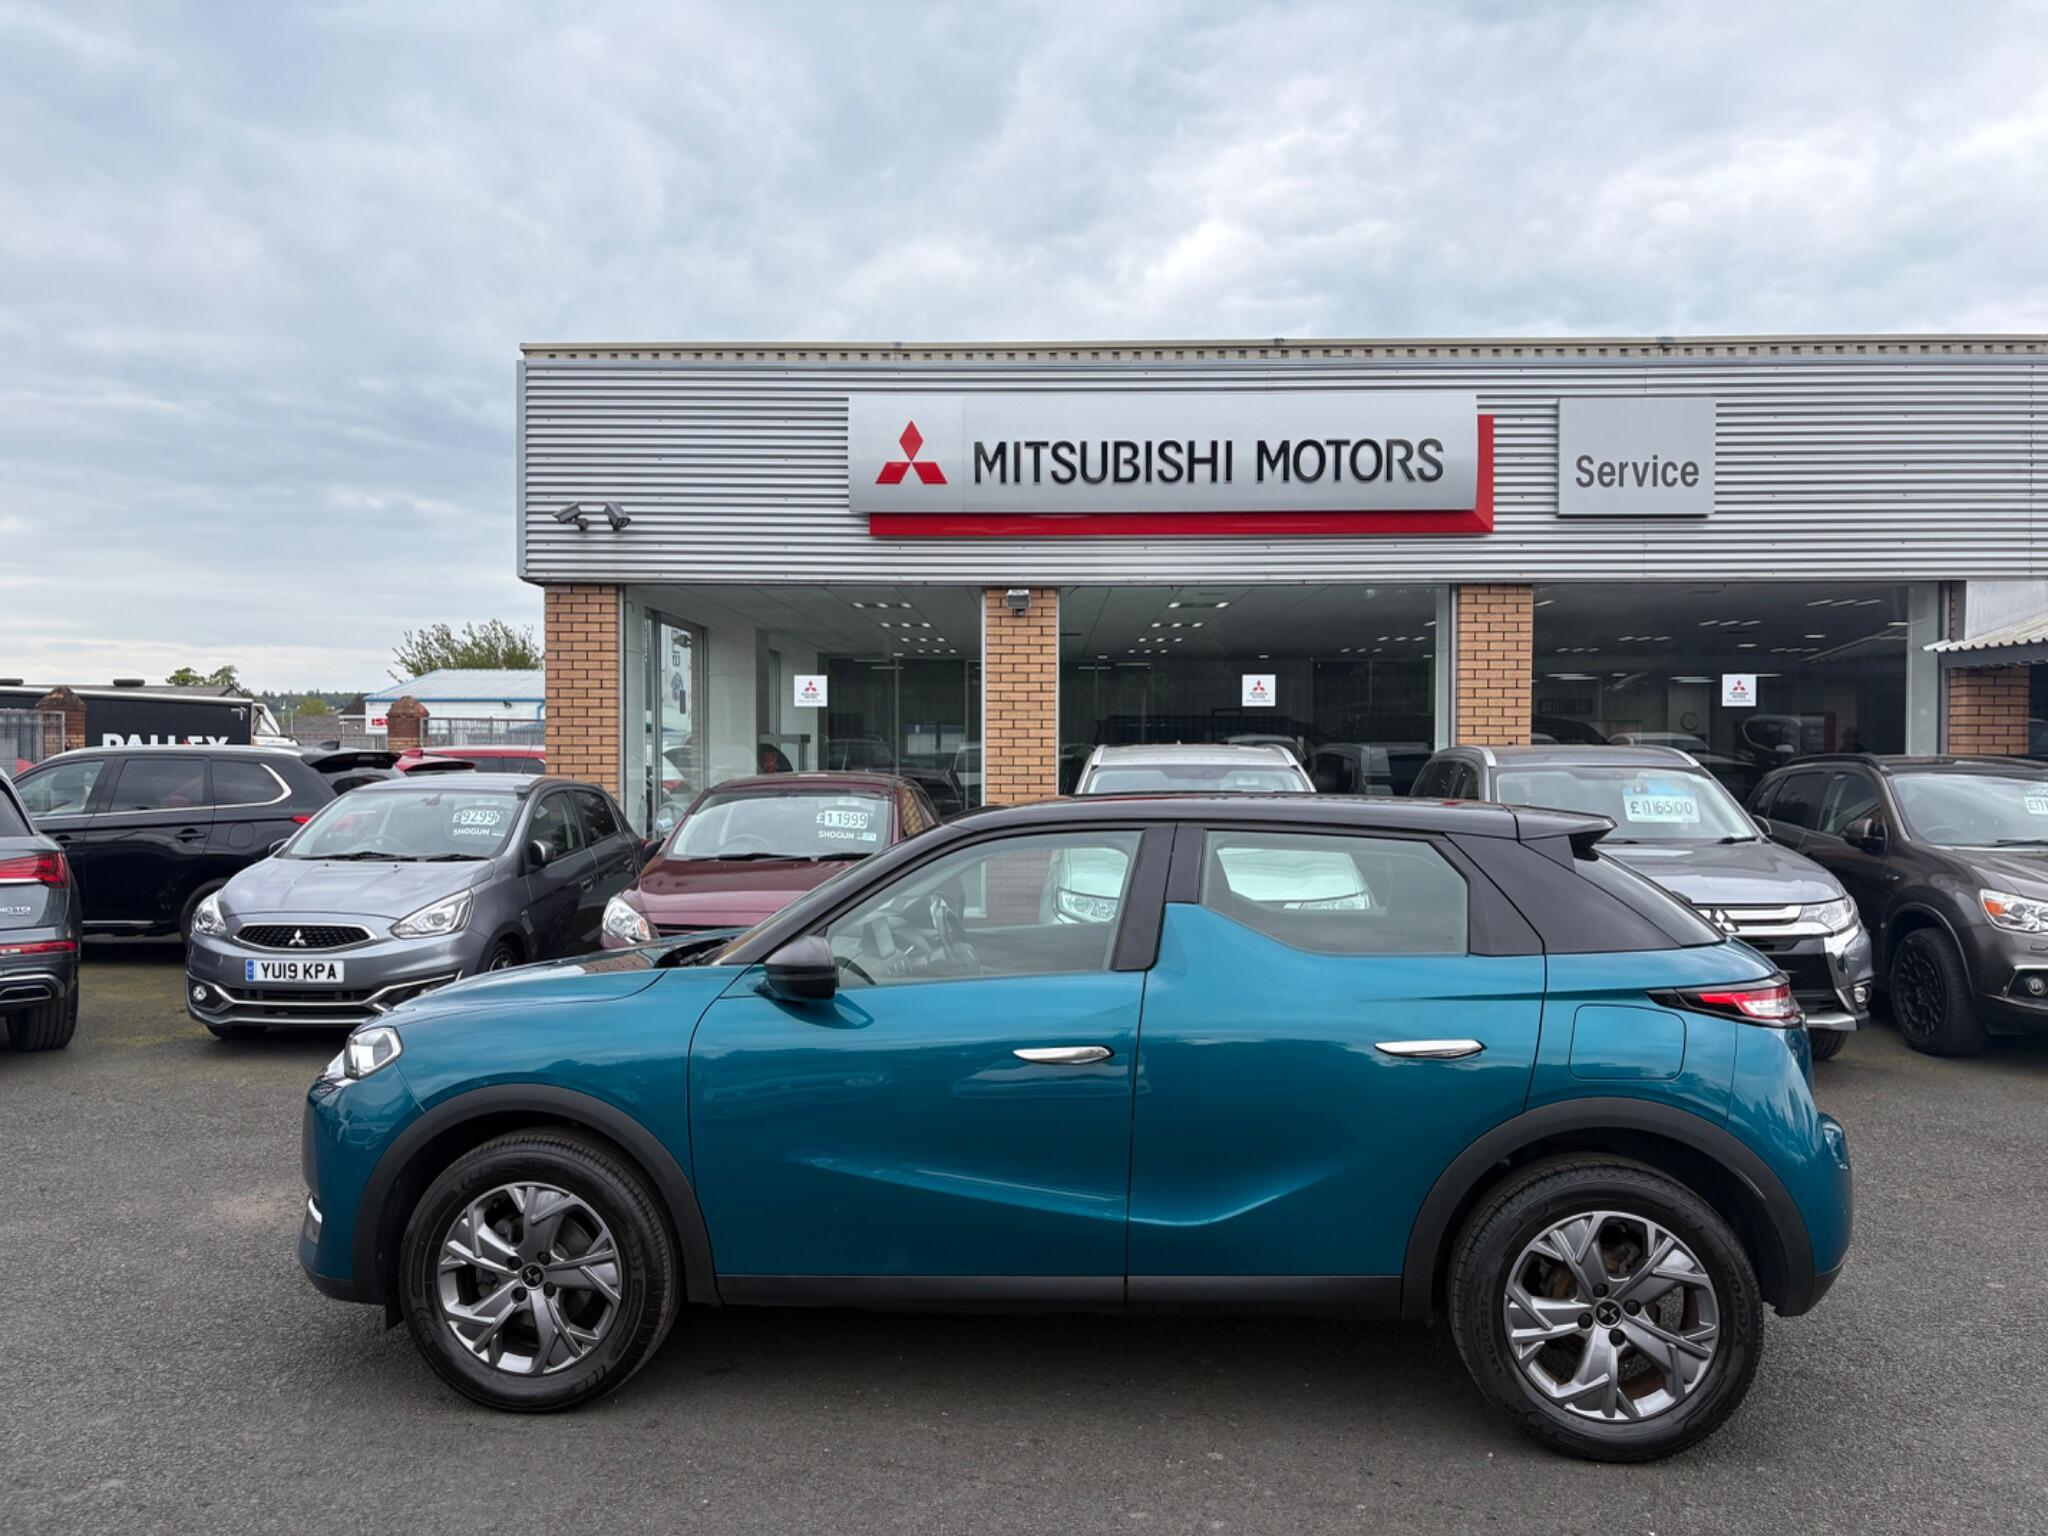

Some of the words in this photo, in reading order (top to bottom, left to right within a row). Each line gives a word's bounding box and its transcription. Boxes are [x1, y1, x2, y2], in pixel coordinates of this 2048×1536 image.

[974, 440, 1233, 484] MITSUBISHI
[1257, 438, 1444, 483] MOTORS
[1576, 454, 1699, 488] Service
[453, 827, 490, 836] SHOGUN
[818, 830, 854, 840] SHOGUN
[261, 962, 298, 979] YU19
[303, 963, 337, 979] KPA
